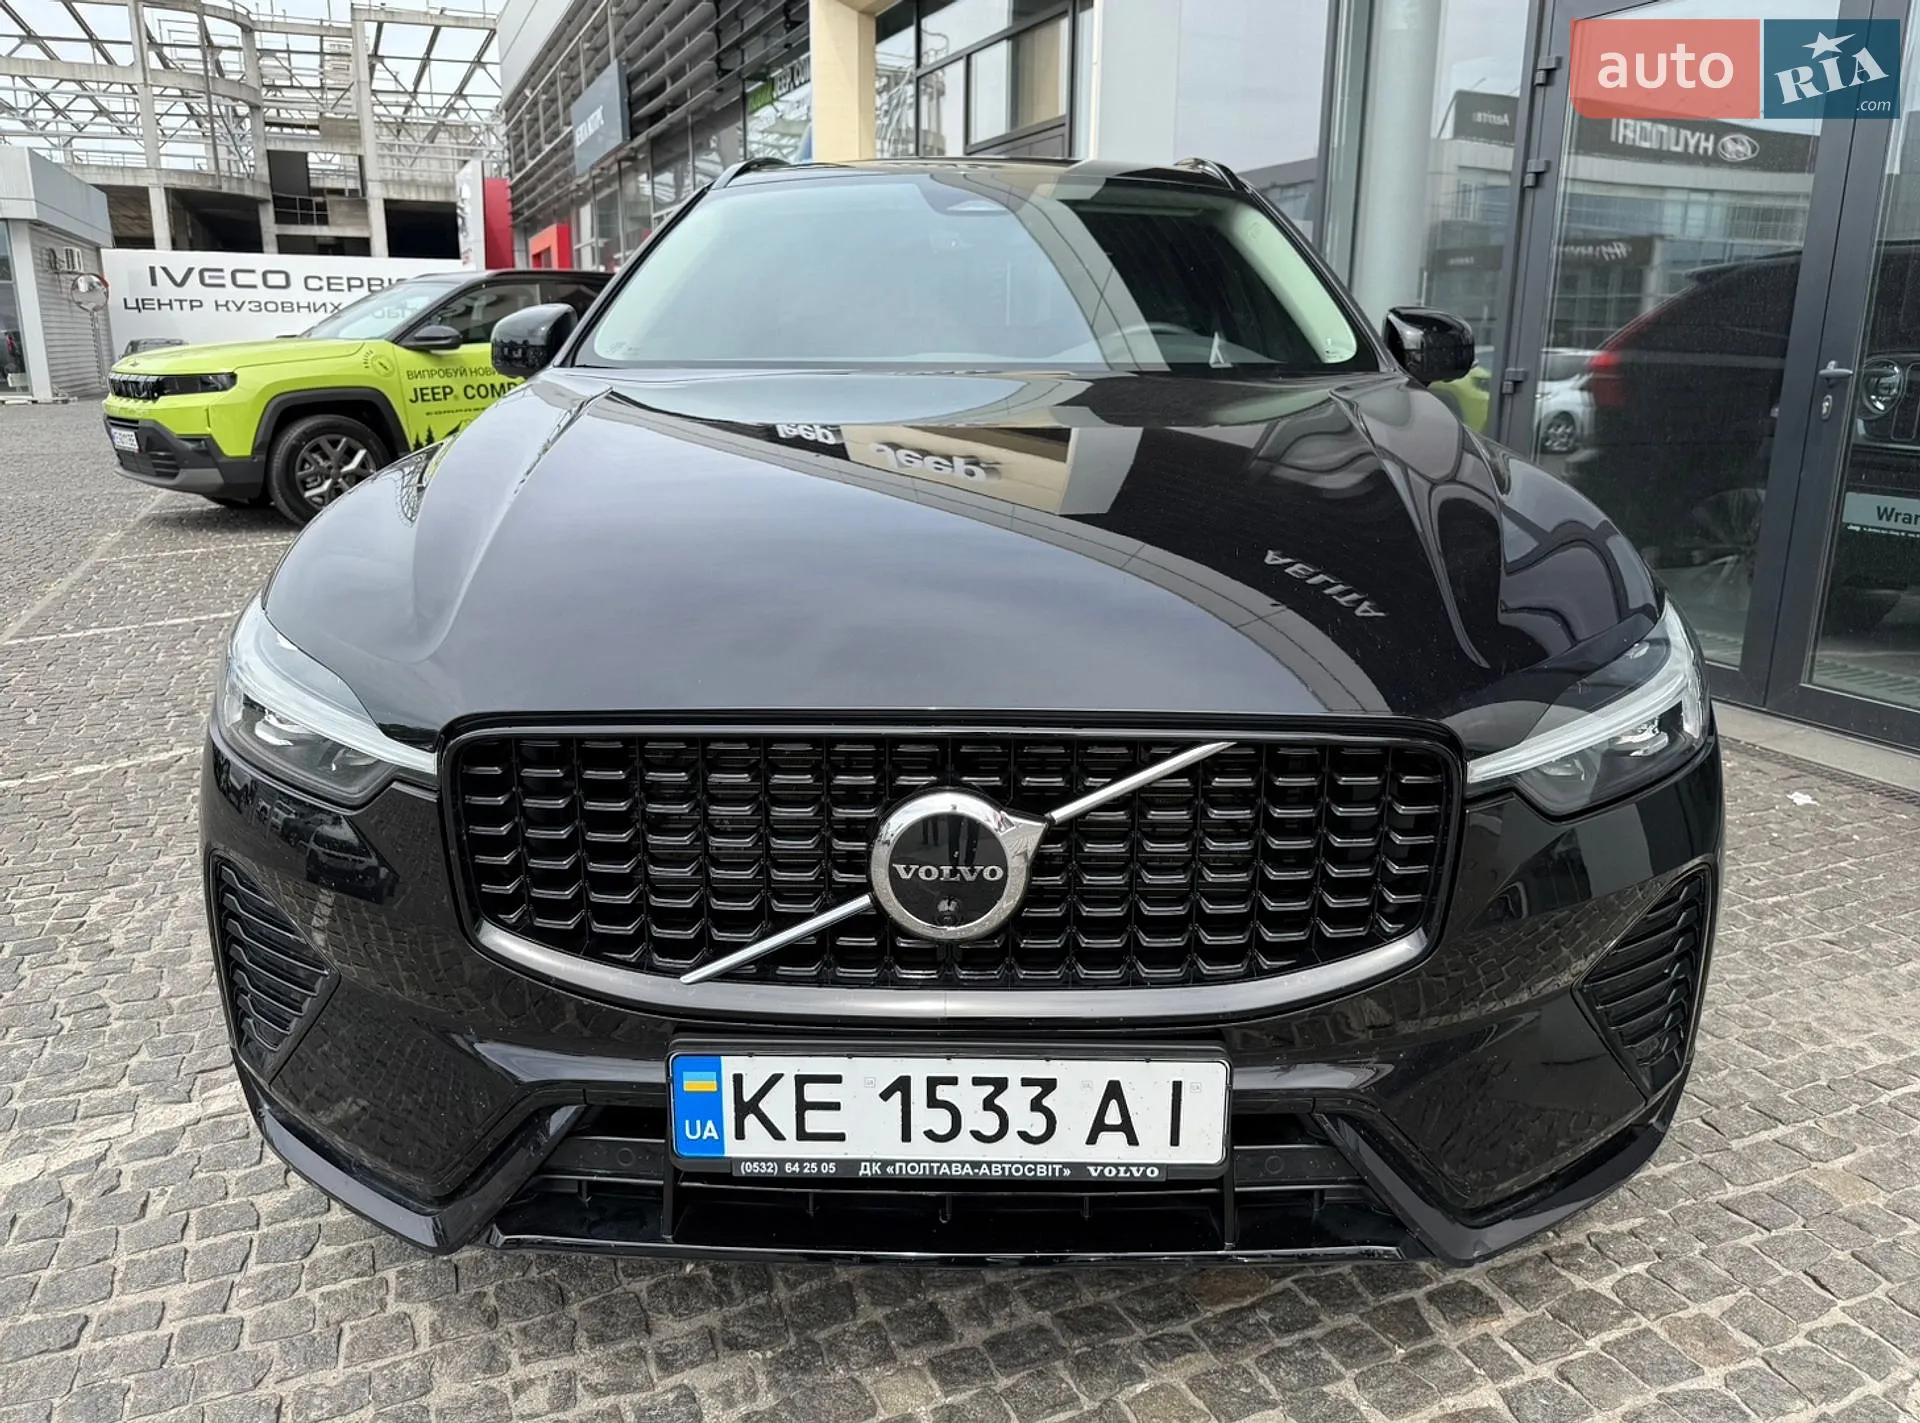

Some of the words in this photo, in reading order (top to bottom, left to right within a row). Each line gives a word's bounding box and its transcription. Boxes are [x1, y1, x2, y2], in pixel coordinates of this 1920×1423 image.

[148, 265, 291, 290] IVECO
[123, 296, 203, 313] ЦЕНТР
[215, 299, 342, 315] КУЗОВНИХ
[406, 365, 467, 381] ВИПРОБУЙ
[892, 863, 1004, 882] VOLVO
[732, 1072, 847, 1142] KE
[878, 1074, 1058, 1146] 1533
[685, 1119, 719, 1140] UA
[740, 1161, 778, 1176] (0532)
[785, 1162, 800, 1174] 64
[803, 1162, 818, 1174] 25
[820, 1162, 836, 1174] 05
[858, 1162, 882, 1177] ДК
[886, 1162, 1071, 1178] «ПОЛТАВА-АВТОСВІТ»
[1087, 1166, 1160, 1178] VOLVO
